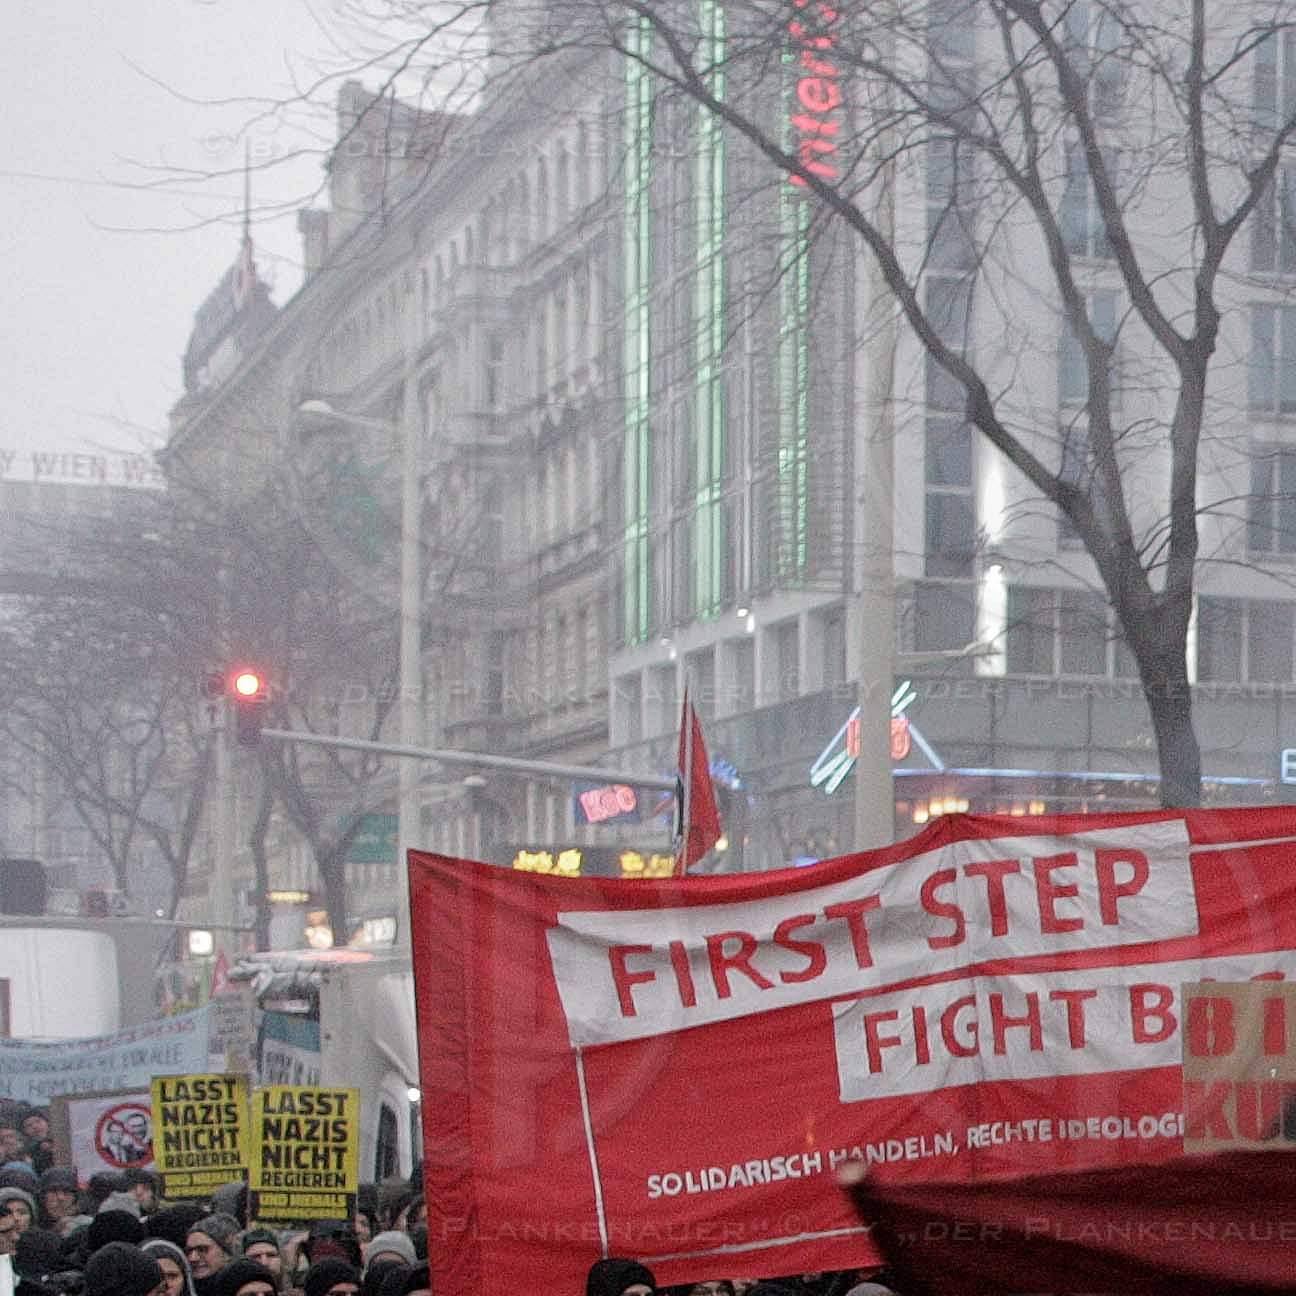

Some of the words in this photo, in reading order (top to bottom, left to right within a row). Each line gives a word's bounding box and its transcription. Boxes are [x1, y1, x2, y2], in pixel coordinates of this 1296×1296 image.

[606, 895, 882, 1017] FIRST
[918, 846, 1151, 949] STEP
[863, 988, 1113, 1074] FIGHT
[159, 1078, 236, 1103] LASST
[161, 1103, 239, 1127] NAZIS
[262, 1091, 349, 1116] LASST
[163, 1127, 240, 1152] NICHT
[261, 1118, 348, 1143] NAZIS
[165, 1151, 241, 1169] REGIEREN
[261, 1145, 348, 1170] NICHT
[646, 1151, 822, 1199] SOLIDARISCH
[967, 1119, 1053, 1150] RECHTE
[1058, 1113, 1186, 1141] IDEOLOGI
[260, 1171, 347, 1188] REGIEREN
